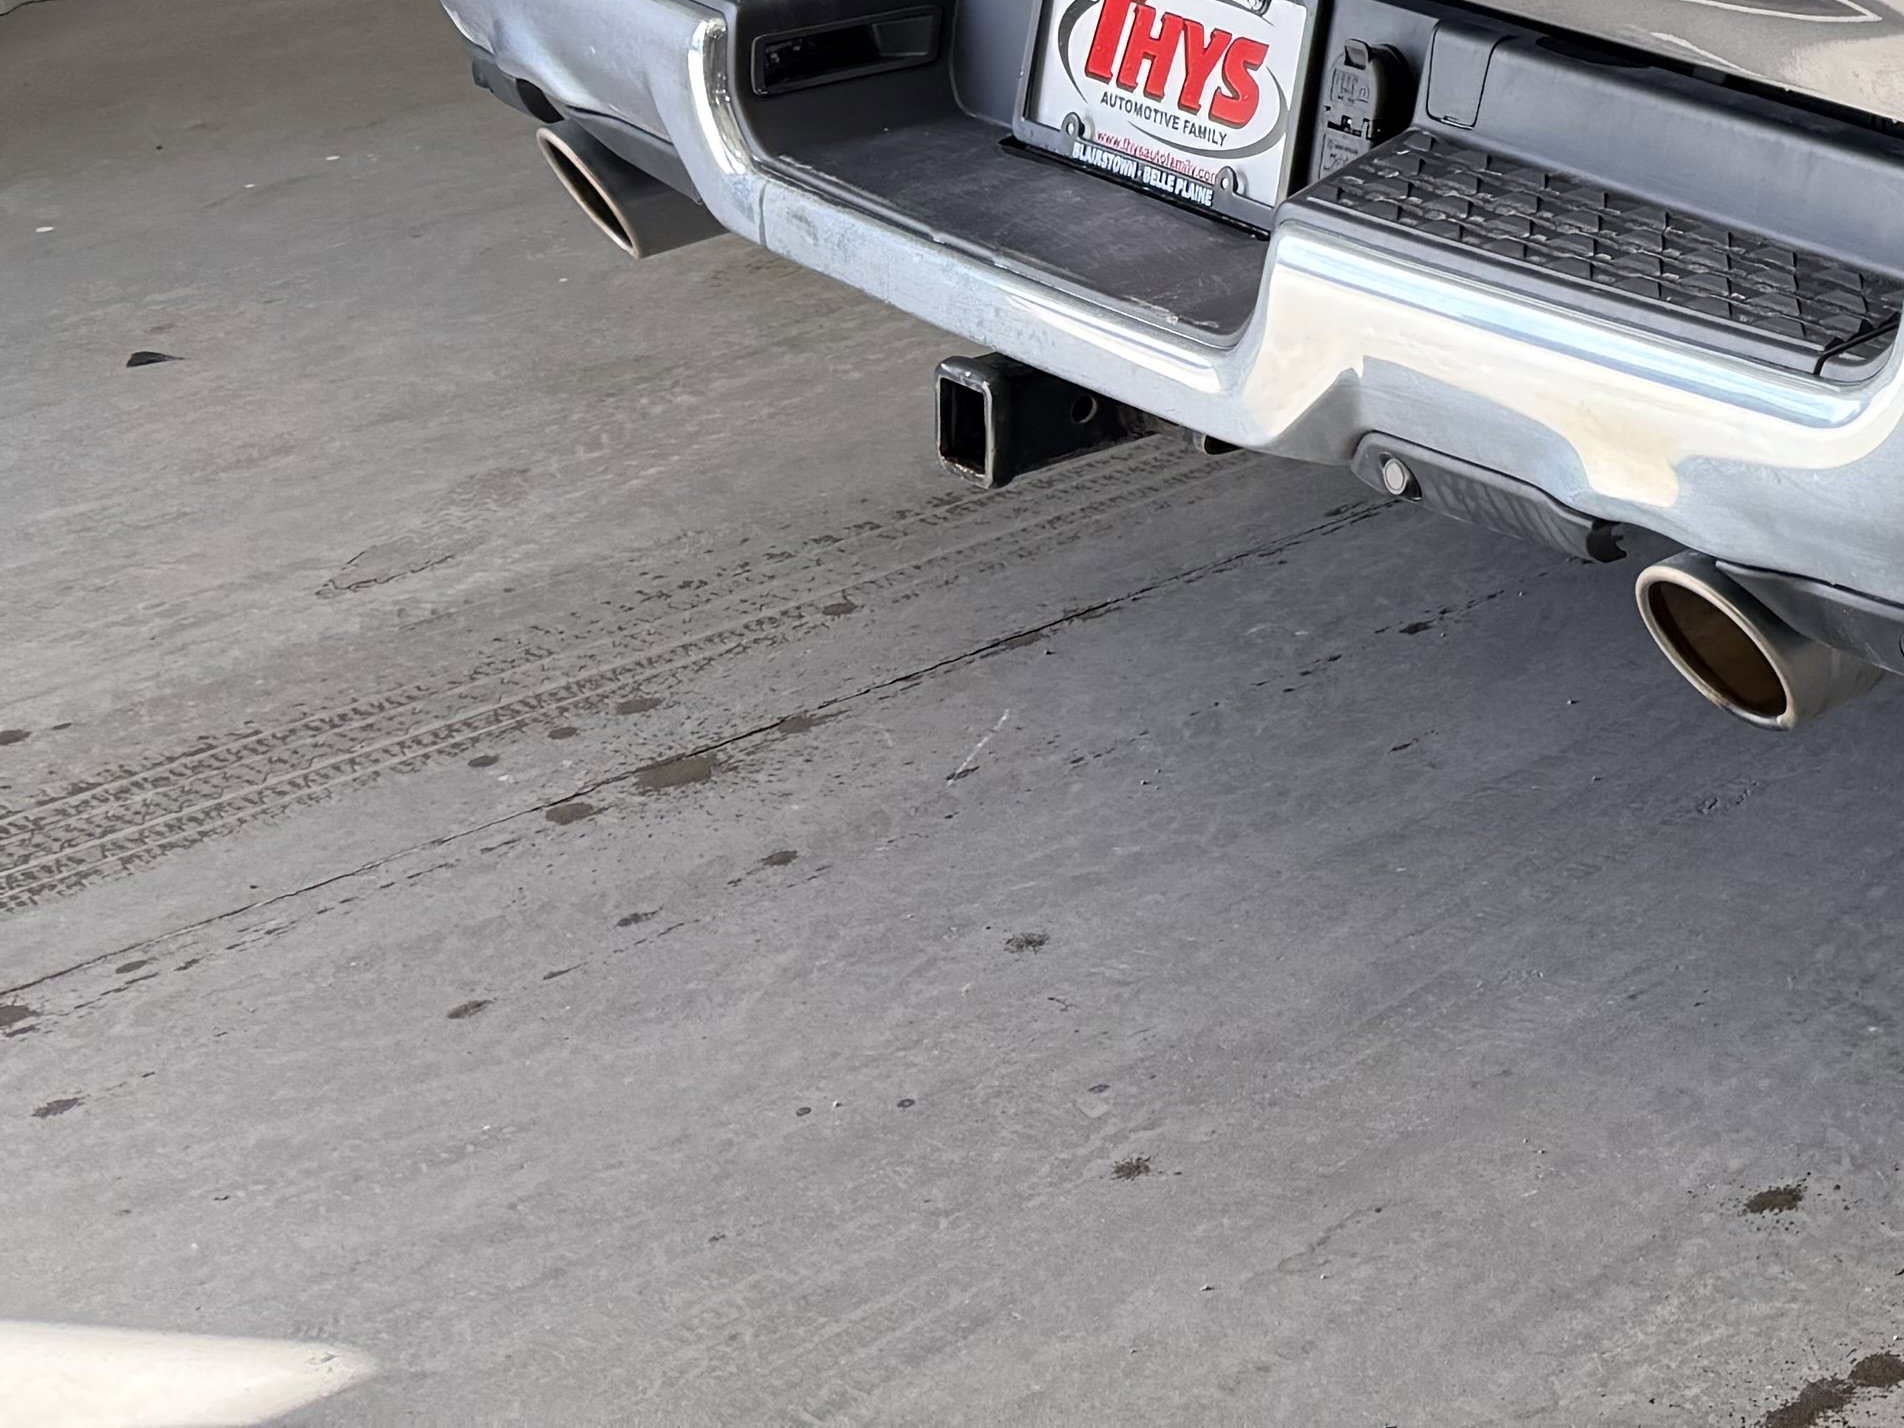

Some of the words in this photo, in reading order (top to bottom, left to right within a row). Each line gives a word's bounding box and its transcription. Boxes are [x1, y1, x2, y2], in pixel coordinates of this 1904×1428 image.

[1100, 91, 1180, 130] AUTOMOTIVE
[1183, 119, 1228, 148] FAMILY
[1142, 165, 1176, 193] BELLE
[1175, 177, 1214, 207] PLAINE
